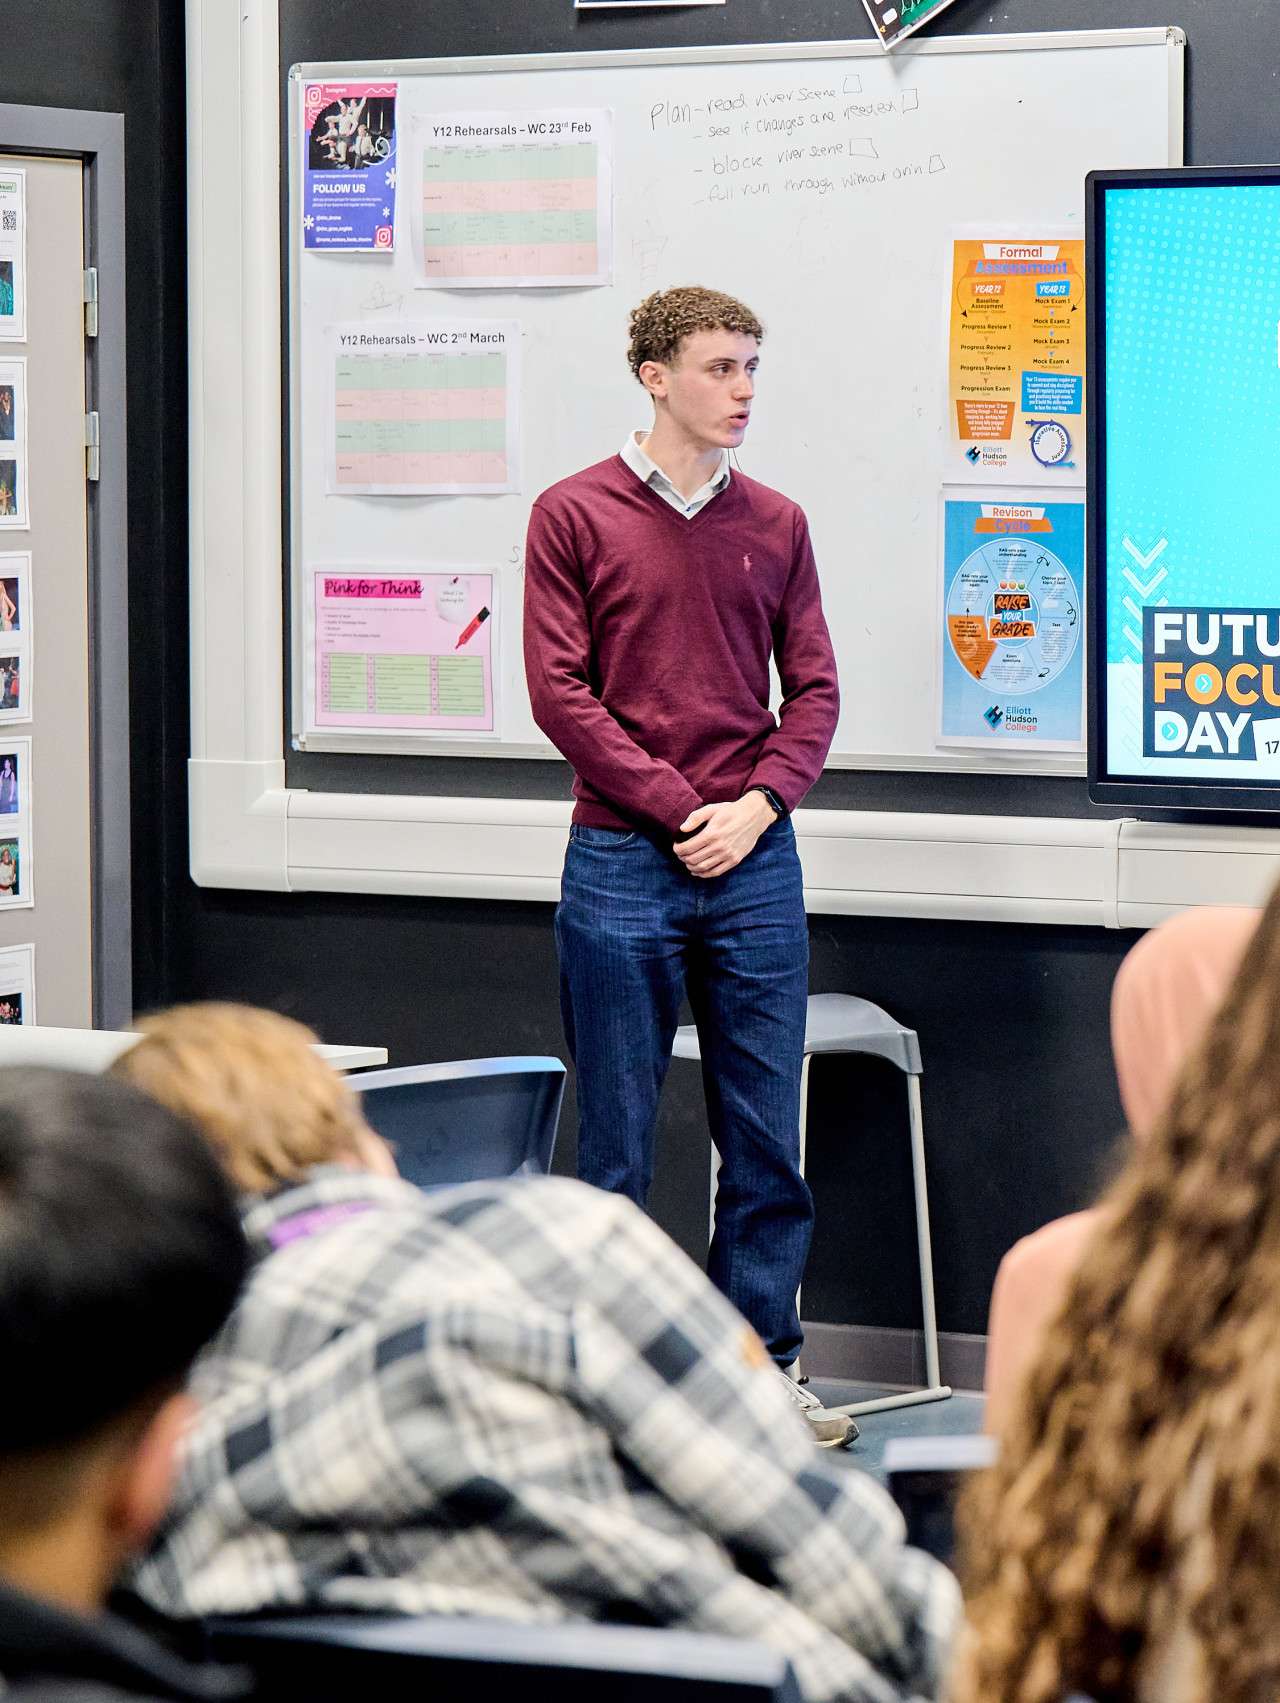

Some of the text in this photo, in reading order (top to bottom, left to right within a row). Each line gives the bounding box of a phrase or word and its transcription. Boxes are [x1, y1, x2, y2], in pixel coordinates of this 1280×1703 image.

[432, 120, 592, 137] Y12 Rehearsals WC 23rd Feb
[313, 183, 366, 194] FOLLOW US
[1000, 246, 1042, 258] Formal
[975, 260, 1067, 273] Assessment
[1039, 284, 1057, 294] YEAR
[340, 332, 505, 346] Y12 Rehearsals WC 2nd March
[982, 452, 1007, 460] Hudson
[982, 459, 1007, 467] College
[992, 506, 1033, 518] Revison
[995, 519, 1031, 533] Cycle
[324, 579, 424, 597] Pink for Think
[995, 593, 1029, 610] RAISE
[1002, 611, 1022, 622] YOUR
[992, 622, 1031, 637] GRADE
[1005, 706, 1031, 715] Elliott
[1005, 715, 1038, 724] Hudson
[1005, 723, 1037, 733] College
[1154, 710, 1252, 754] DAY
[1265, 741, 1280, 755] 17
